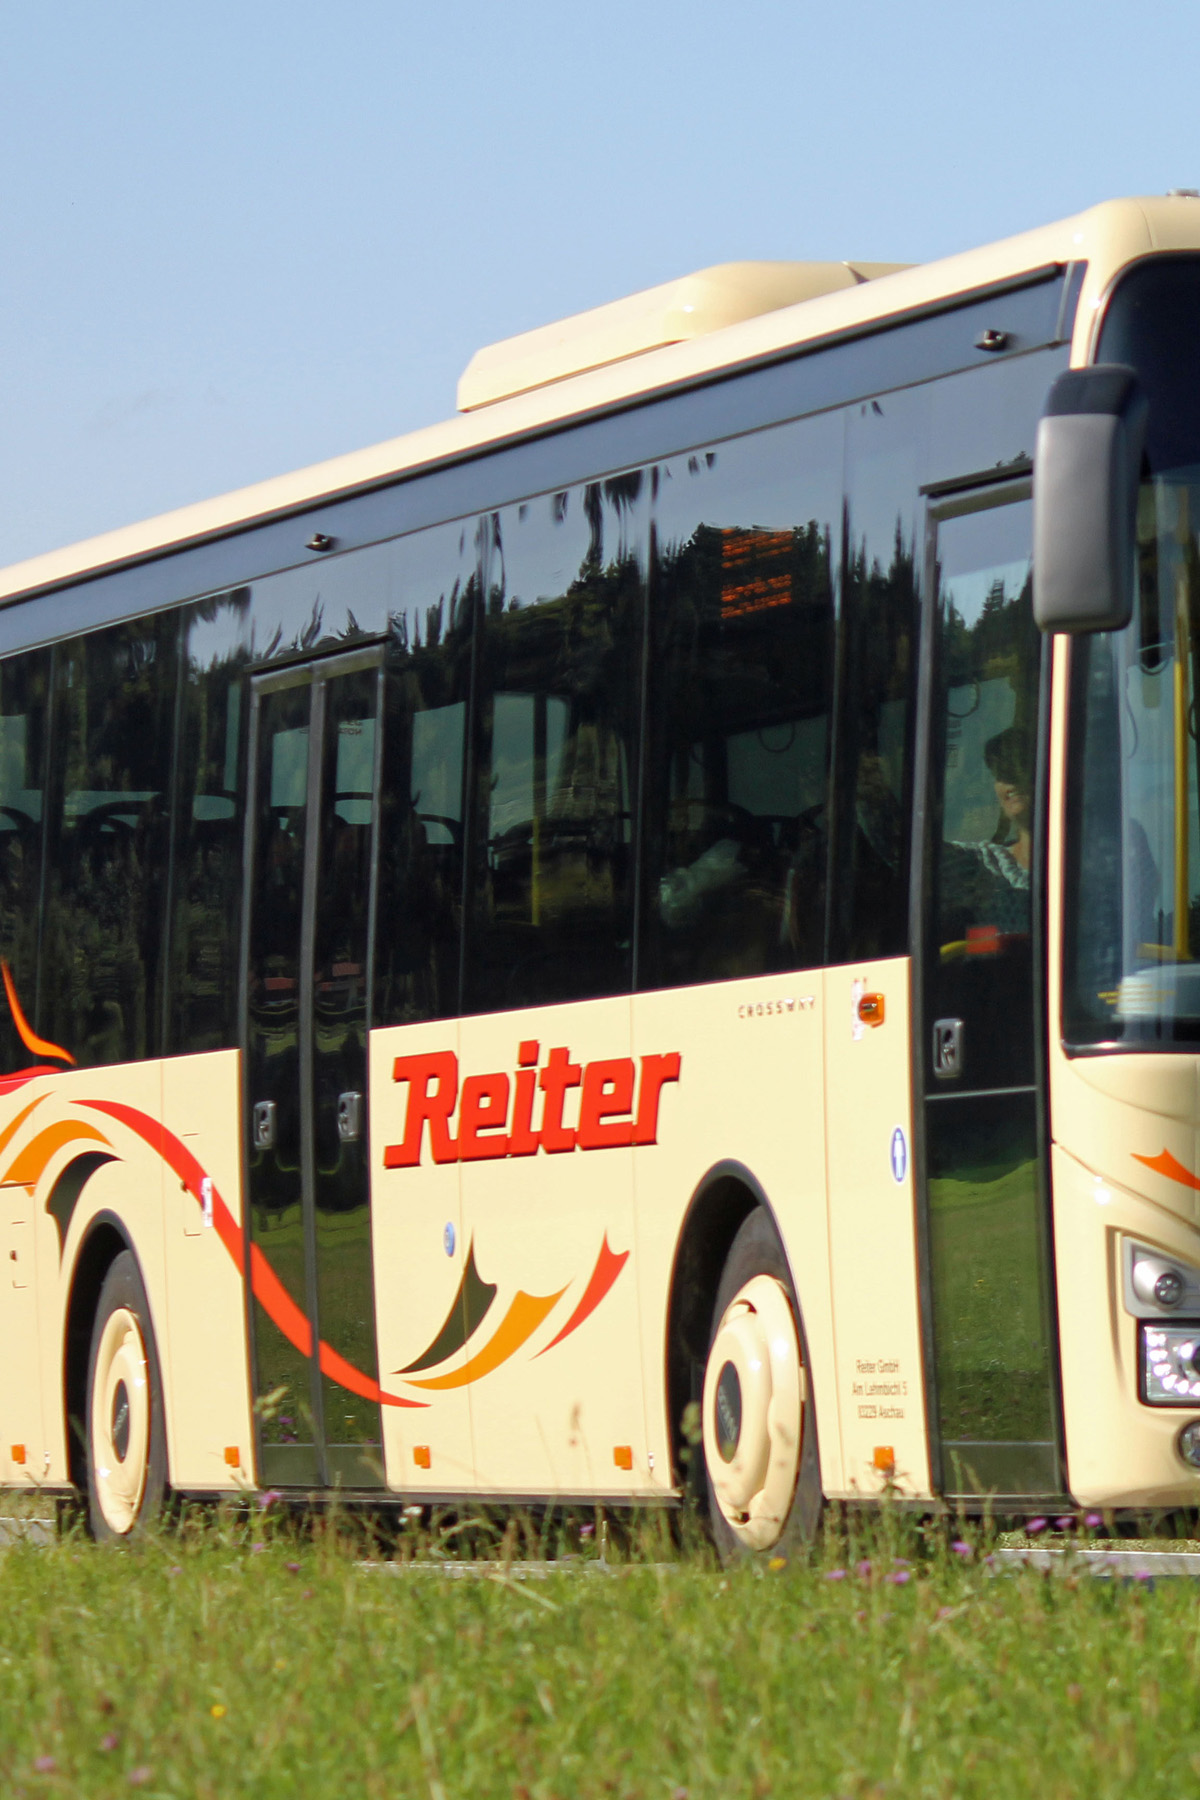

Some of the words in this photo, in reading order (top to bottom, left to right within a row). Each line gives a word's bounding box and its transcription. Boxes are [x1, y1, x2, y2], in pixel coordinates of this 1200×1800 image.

[738, 997, 815, 1019] CROSSWAY
[383, 1039, 682, 1170] Reiter
[856, 1359, 876, 1373] Reiter
